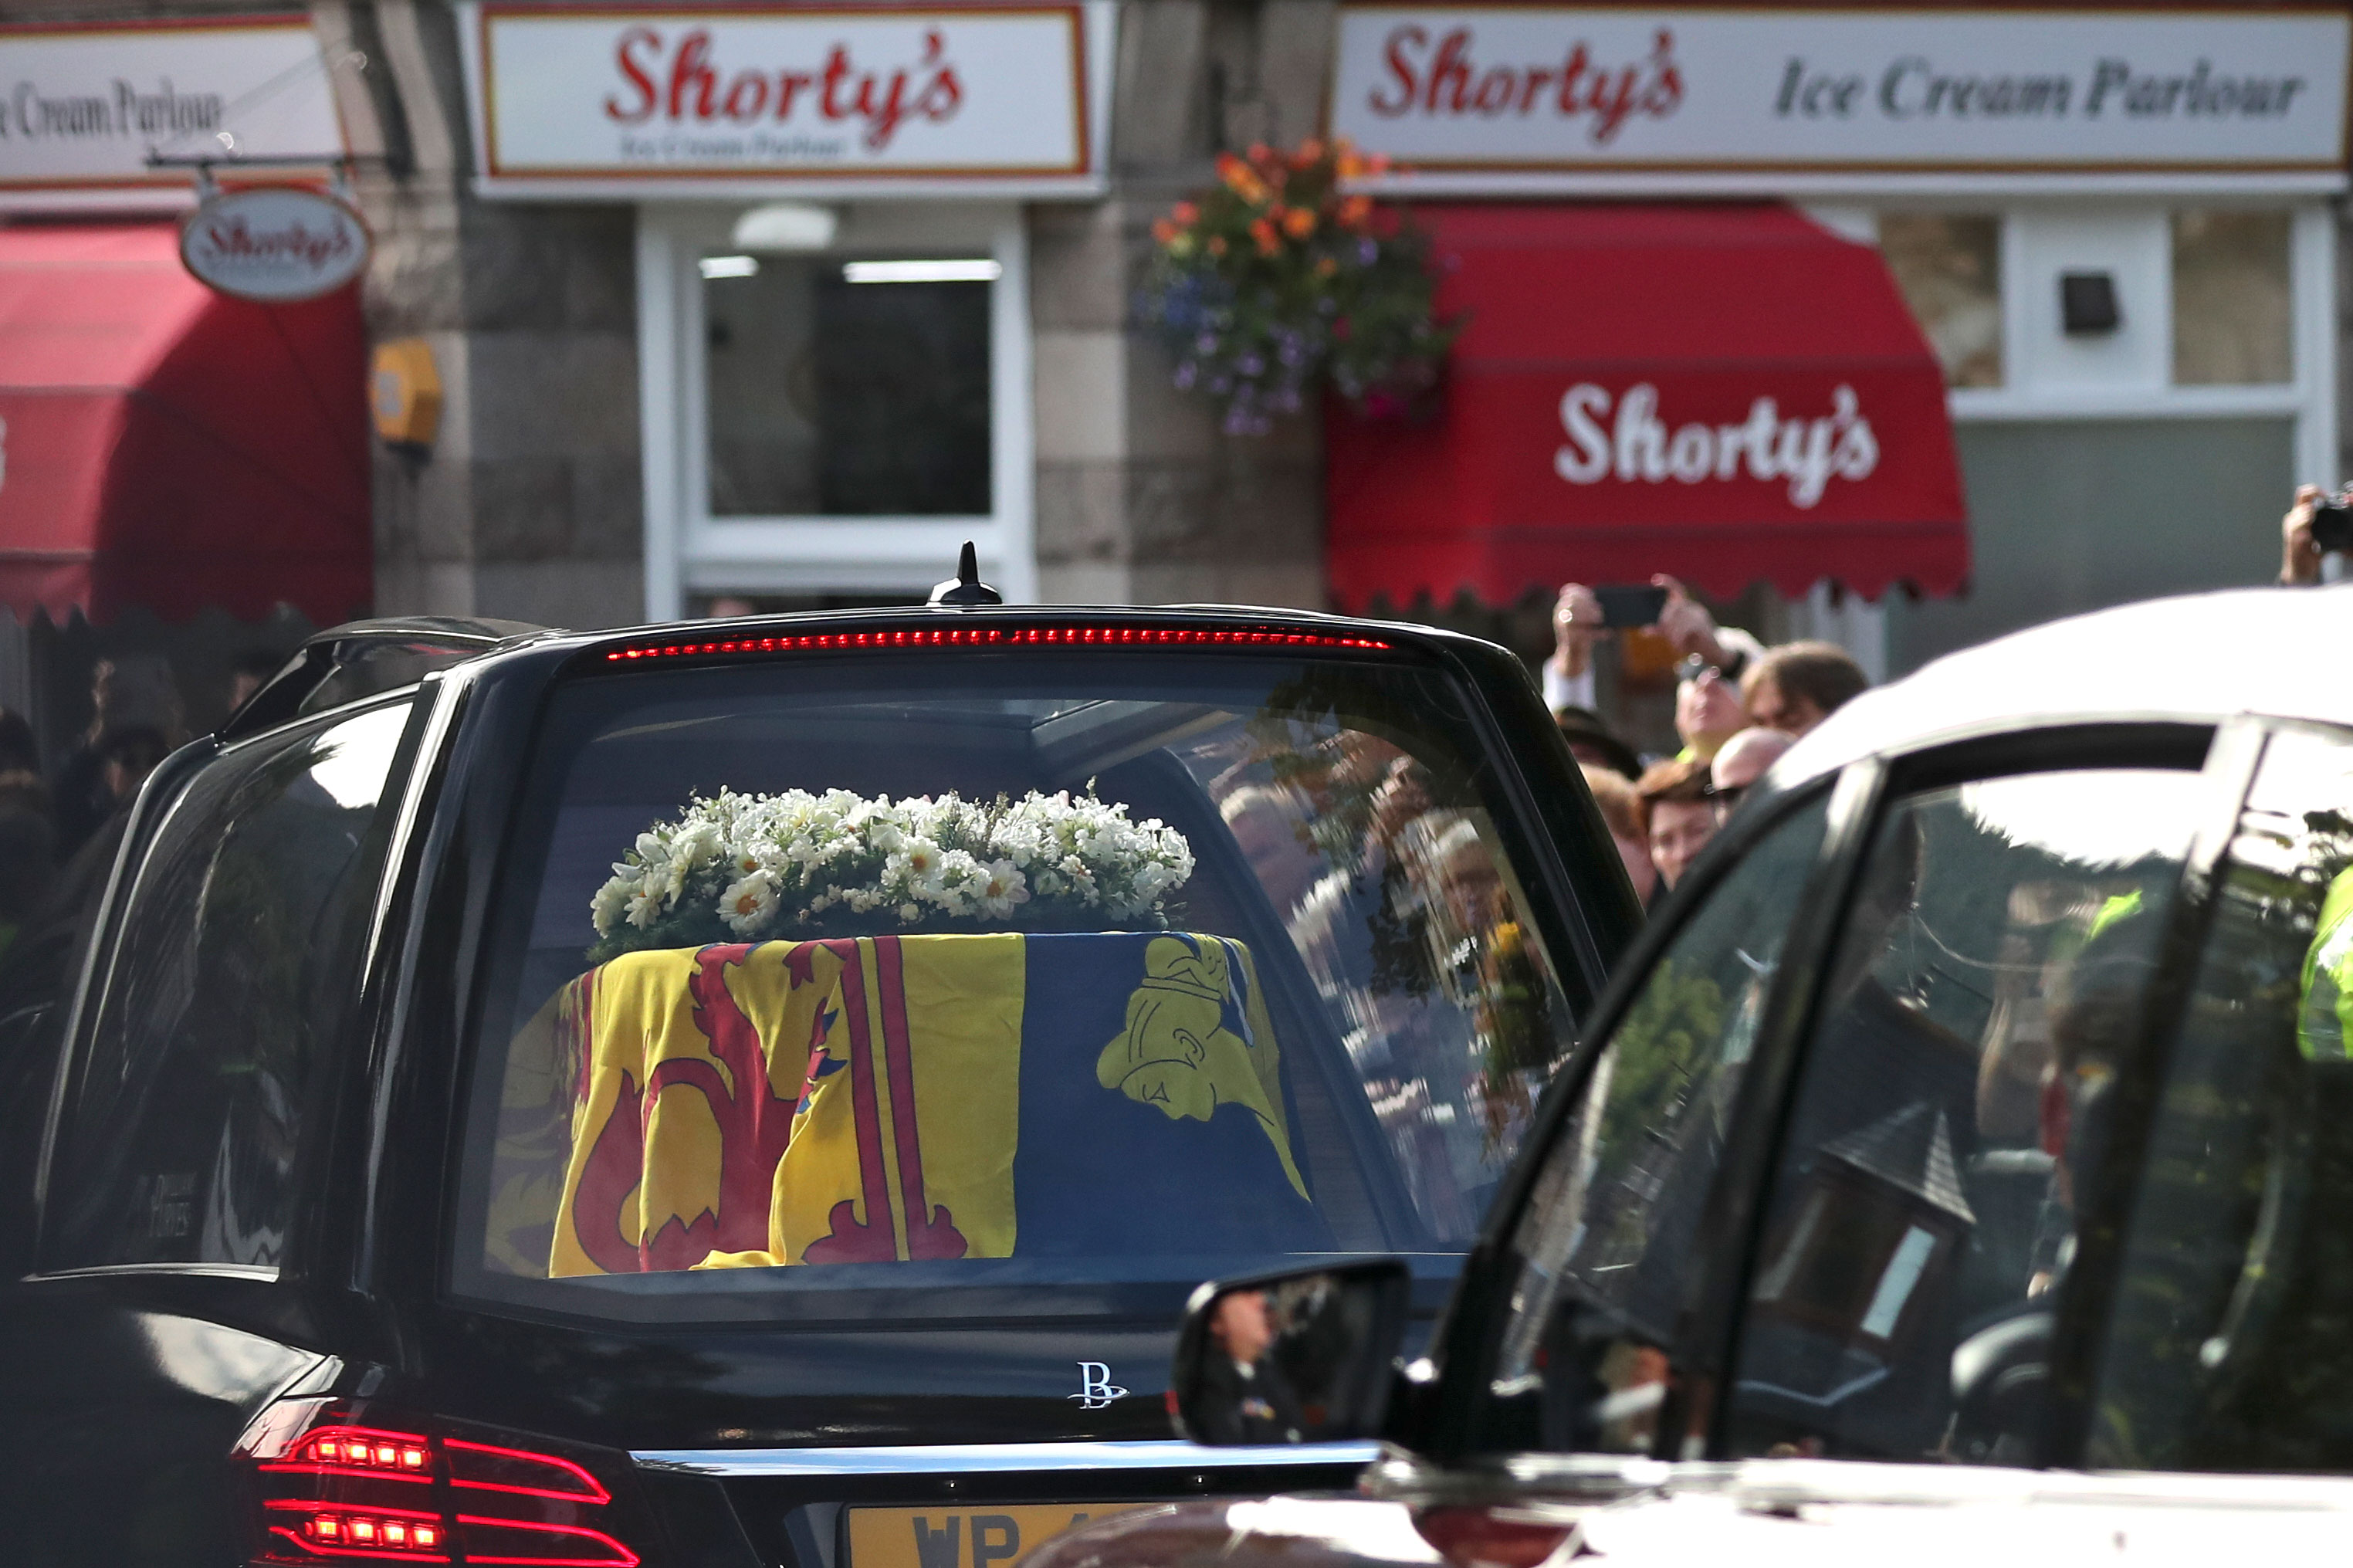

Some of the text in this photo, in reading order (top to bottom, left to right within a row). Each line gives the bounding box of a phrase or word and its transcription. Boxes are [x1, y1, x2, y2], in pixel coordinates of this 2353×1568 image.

[13, 80, 111, 136] Cream
[114, 76, 222, 136] Parlour
[606, 26, 963, 150] Shorty's
[1366, 23, 1684, 147] Shorty's
[1774, 56, 2305, 122] Ice Cream Parlour
[199, 213, 352, 272] Shorty's
[1554, 382, 1881, 510] Shorty's
